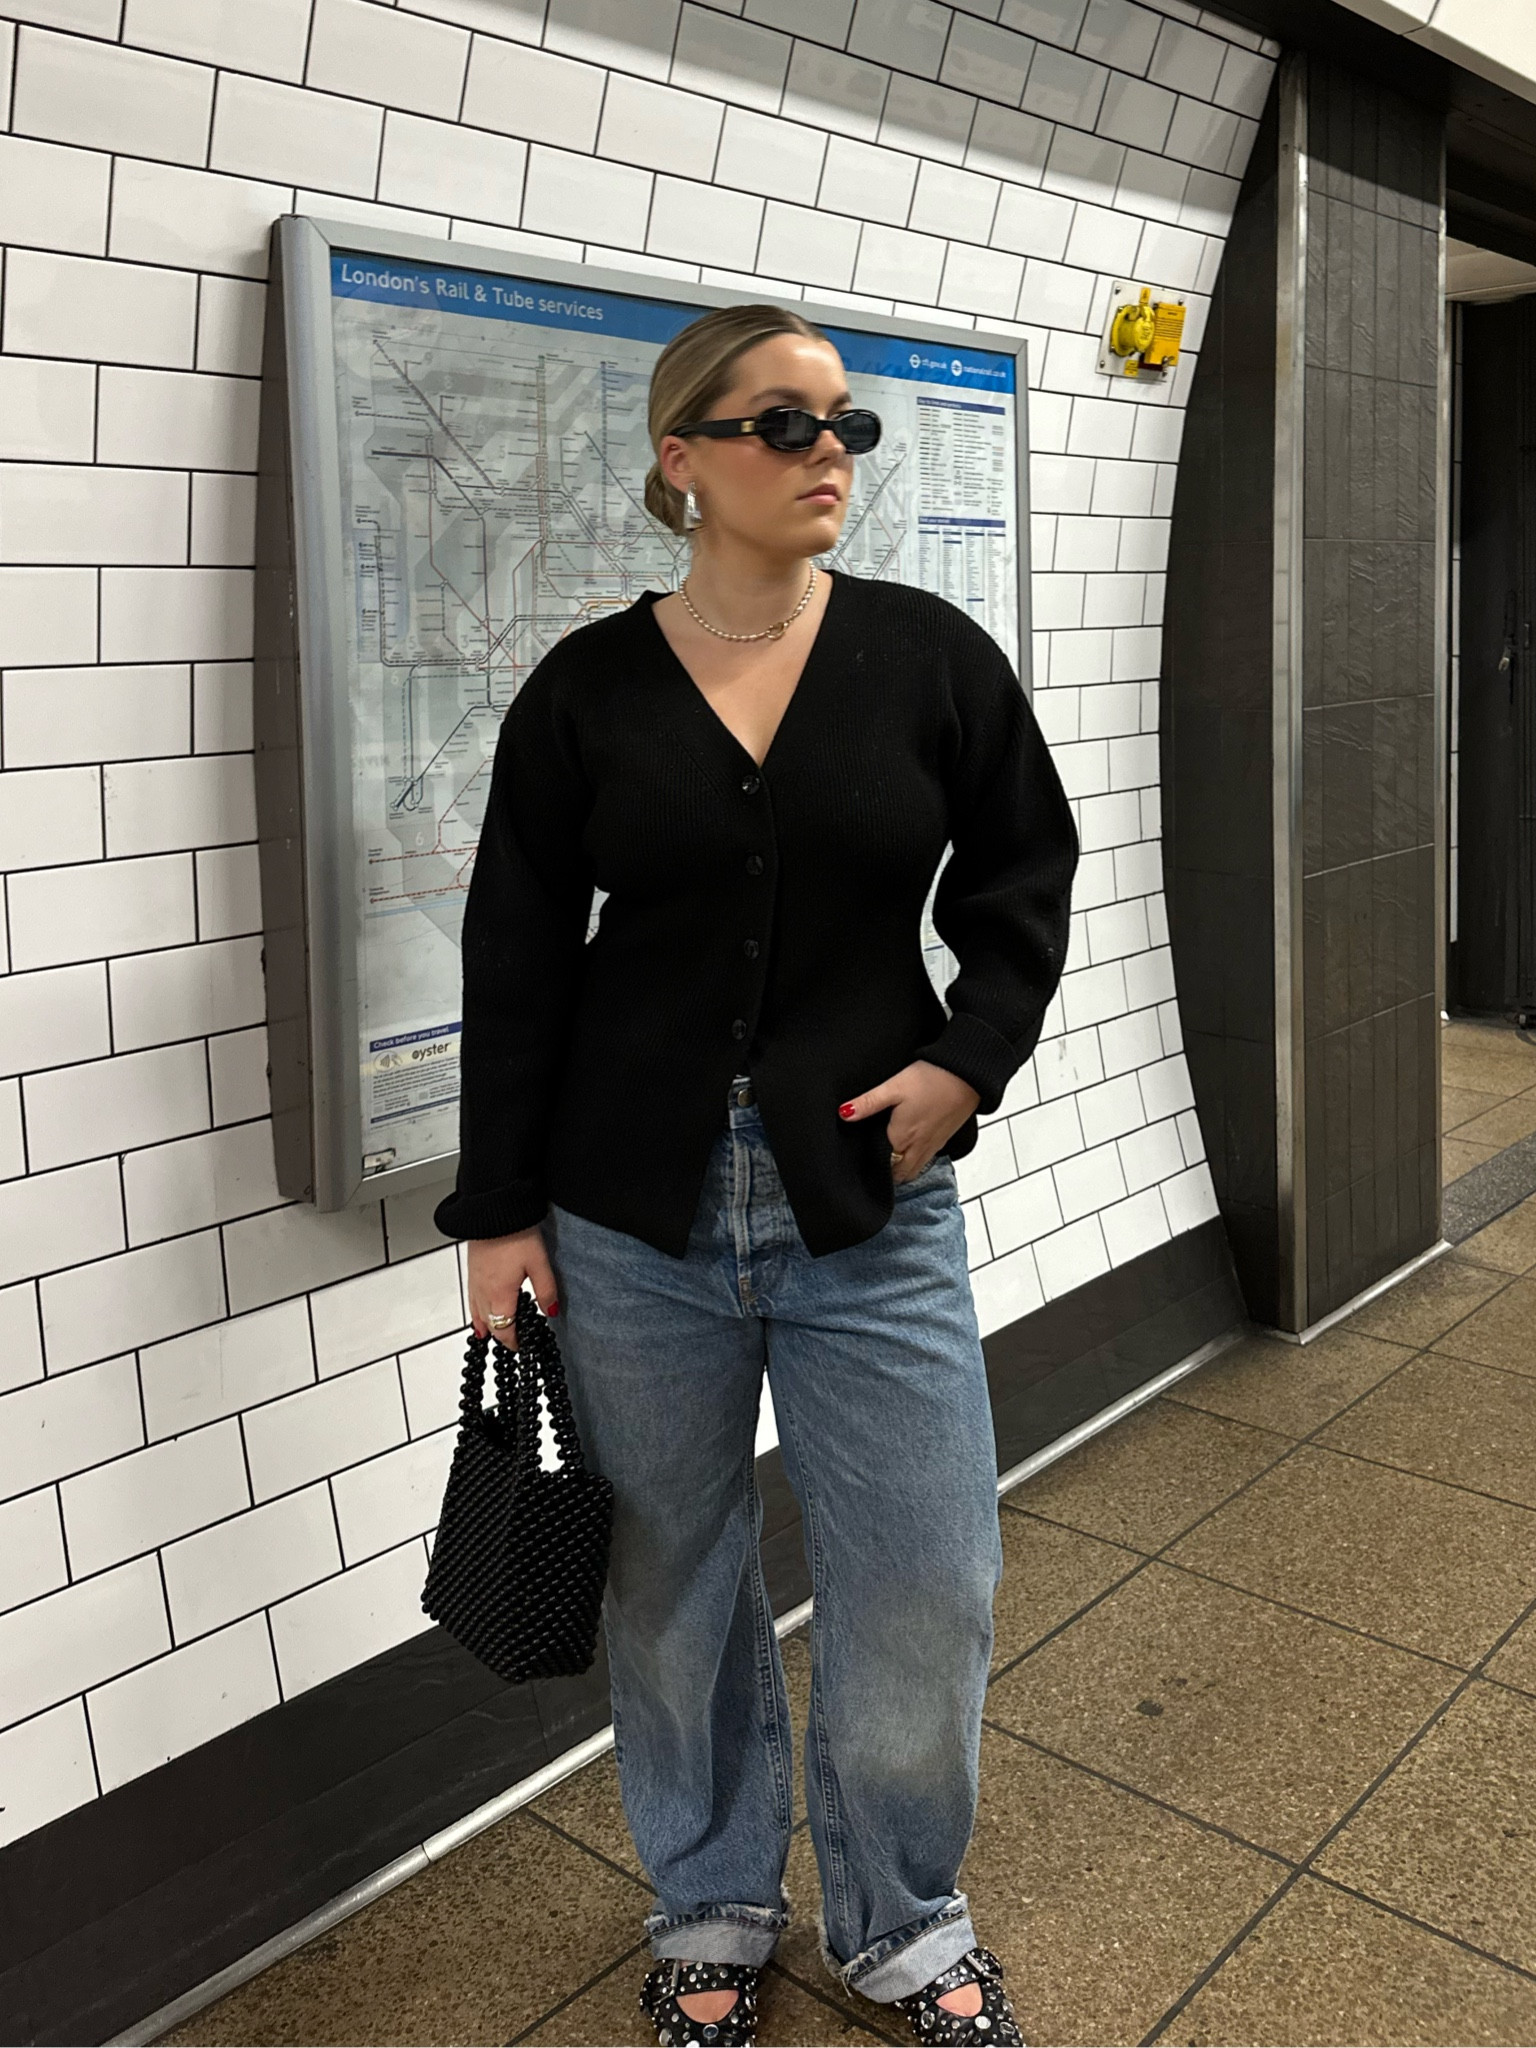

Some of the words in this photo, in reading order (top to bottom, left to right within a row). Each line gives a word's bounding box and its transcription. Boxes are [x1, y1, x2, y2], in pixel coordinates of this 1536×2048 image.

[341, 263, 430, 294] London's
[435, 278, 470, 301] Rail
[474, 284, 488, 303] &
[492, 287, 535, 311] Tube
[538, 297, 604, 321] services
[460, 634, 469, 648] 3
[390, 672, 399, 685] 6
[415, 831, 424, 846] 6
[373, 1039, 394, 1049] Check
[395, 1034, 417, 1045] before
[418, 1031, 430, 1040] you
[431, 1026, 449, 1036] travel
[412, 1042, 449, 1062] oyster
